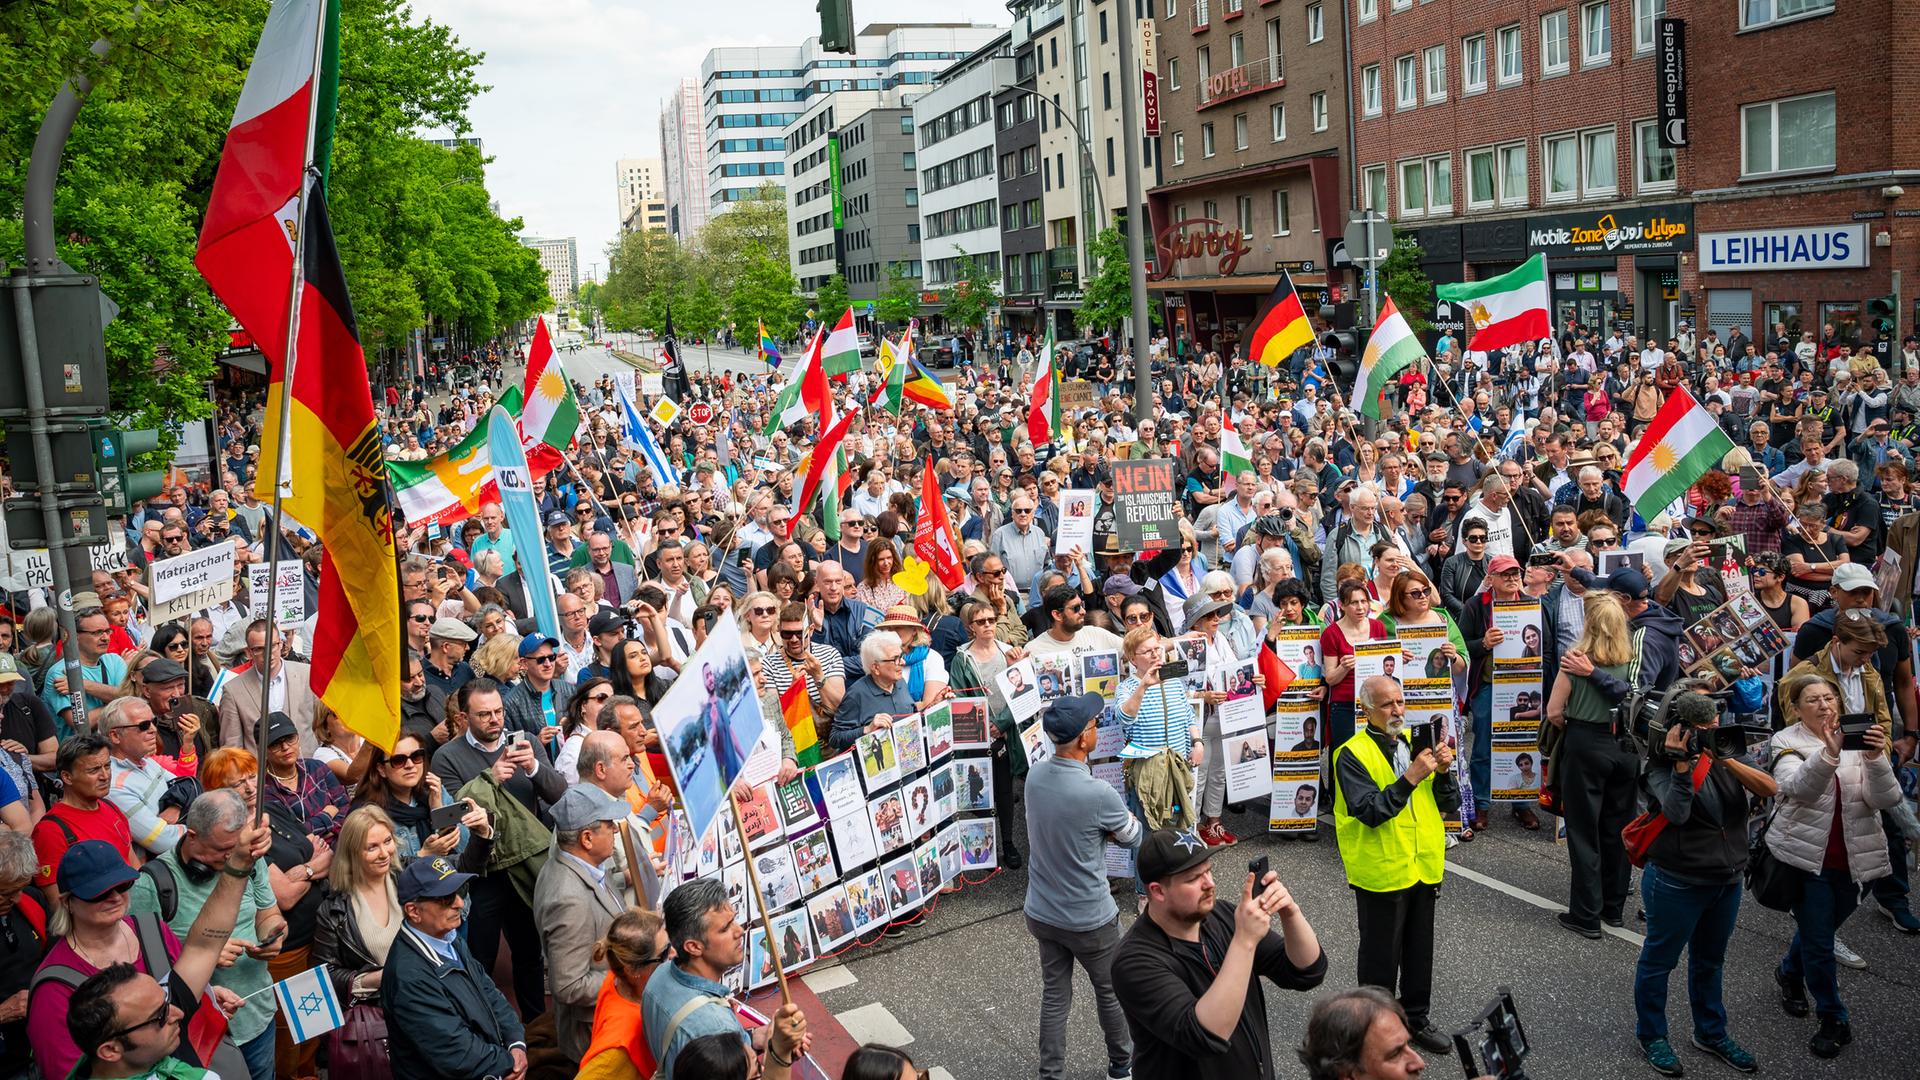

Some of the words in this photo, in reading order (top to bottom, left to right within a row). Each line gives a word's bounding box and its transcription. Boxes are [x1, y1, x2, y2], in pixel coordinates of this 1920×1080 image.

[1143, 21, 1152, 66] HOTEL
[1663, 22, 1678, 117] sleephotels
[1207, 66, 1249, 98] HOTEL
[1146, 80, 1156, 125] SAVOY
[1619, 221, 1643, 241] زون
[1644, 217, 1686, 241] موبايل
[1147, 218, 1252, 281] Savoy
[1711, 231, 1850, 265] LEIHHAUS
[1165, 296, 1186, 308] HOTEL
[691, 407, 711, 419] STOP
[1114, 463, 1173, 494] NEIN
[1124, 492, 1173, 507] ISLAMISCHEN
[1126, 503, 1174, 523] REPUBLIK
[26, 555, 46, 569] I'LL
[93, 551, 127, 571] BACK
[156, 551, 232, 582] Matriarchart
[25, 567, 52, 587] PAC
[180, 570, 209, 590] statt
